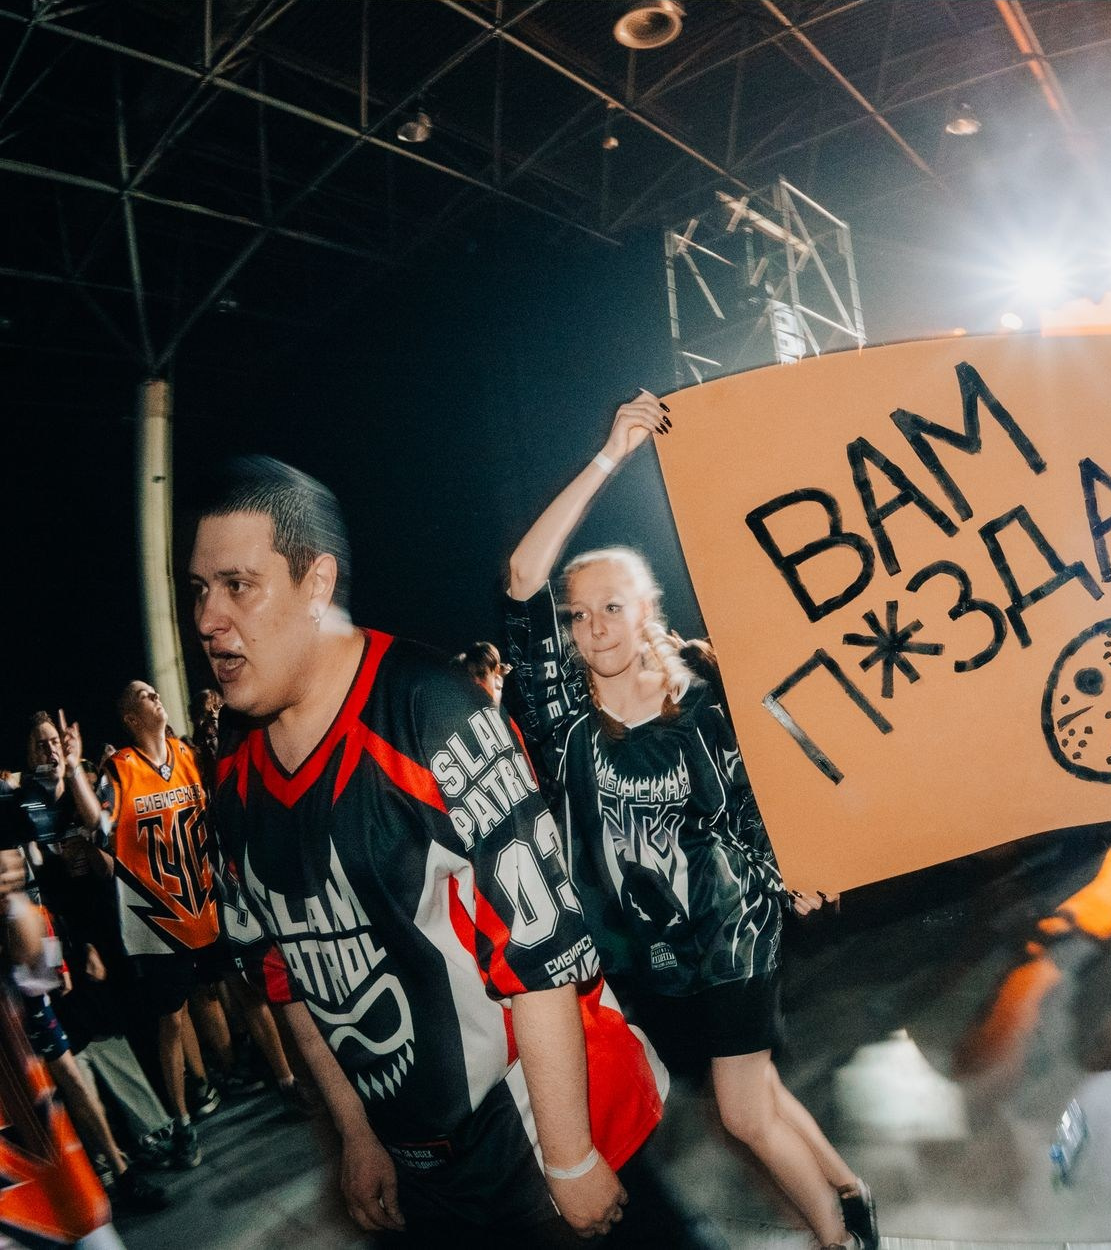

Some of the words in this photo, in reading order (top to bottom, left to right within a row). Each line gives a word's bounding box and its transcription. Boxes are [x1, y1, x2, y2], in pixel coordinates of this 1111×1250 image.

[745, 361, 1046, 622] ВАМ
[541, 636, 563, 720] FREE
[448, 752, 540, 852] PATRO
[279, 932, 389, 1006] ATROL
